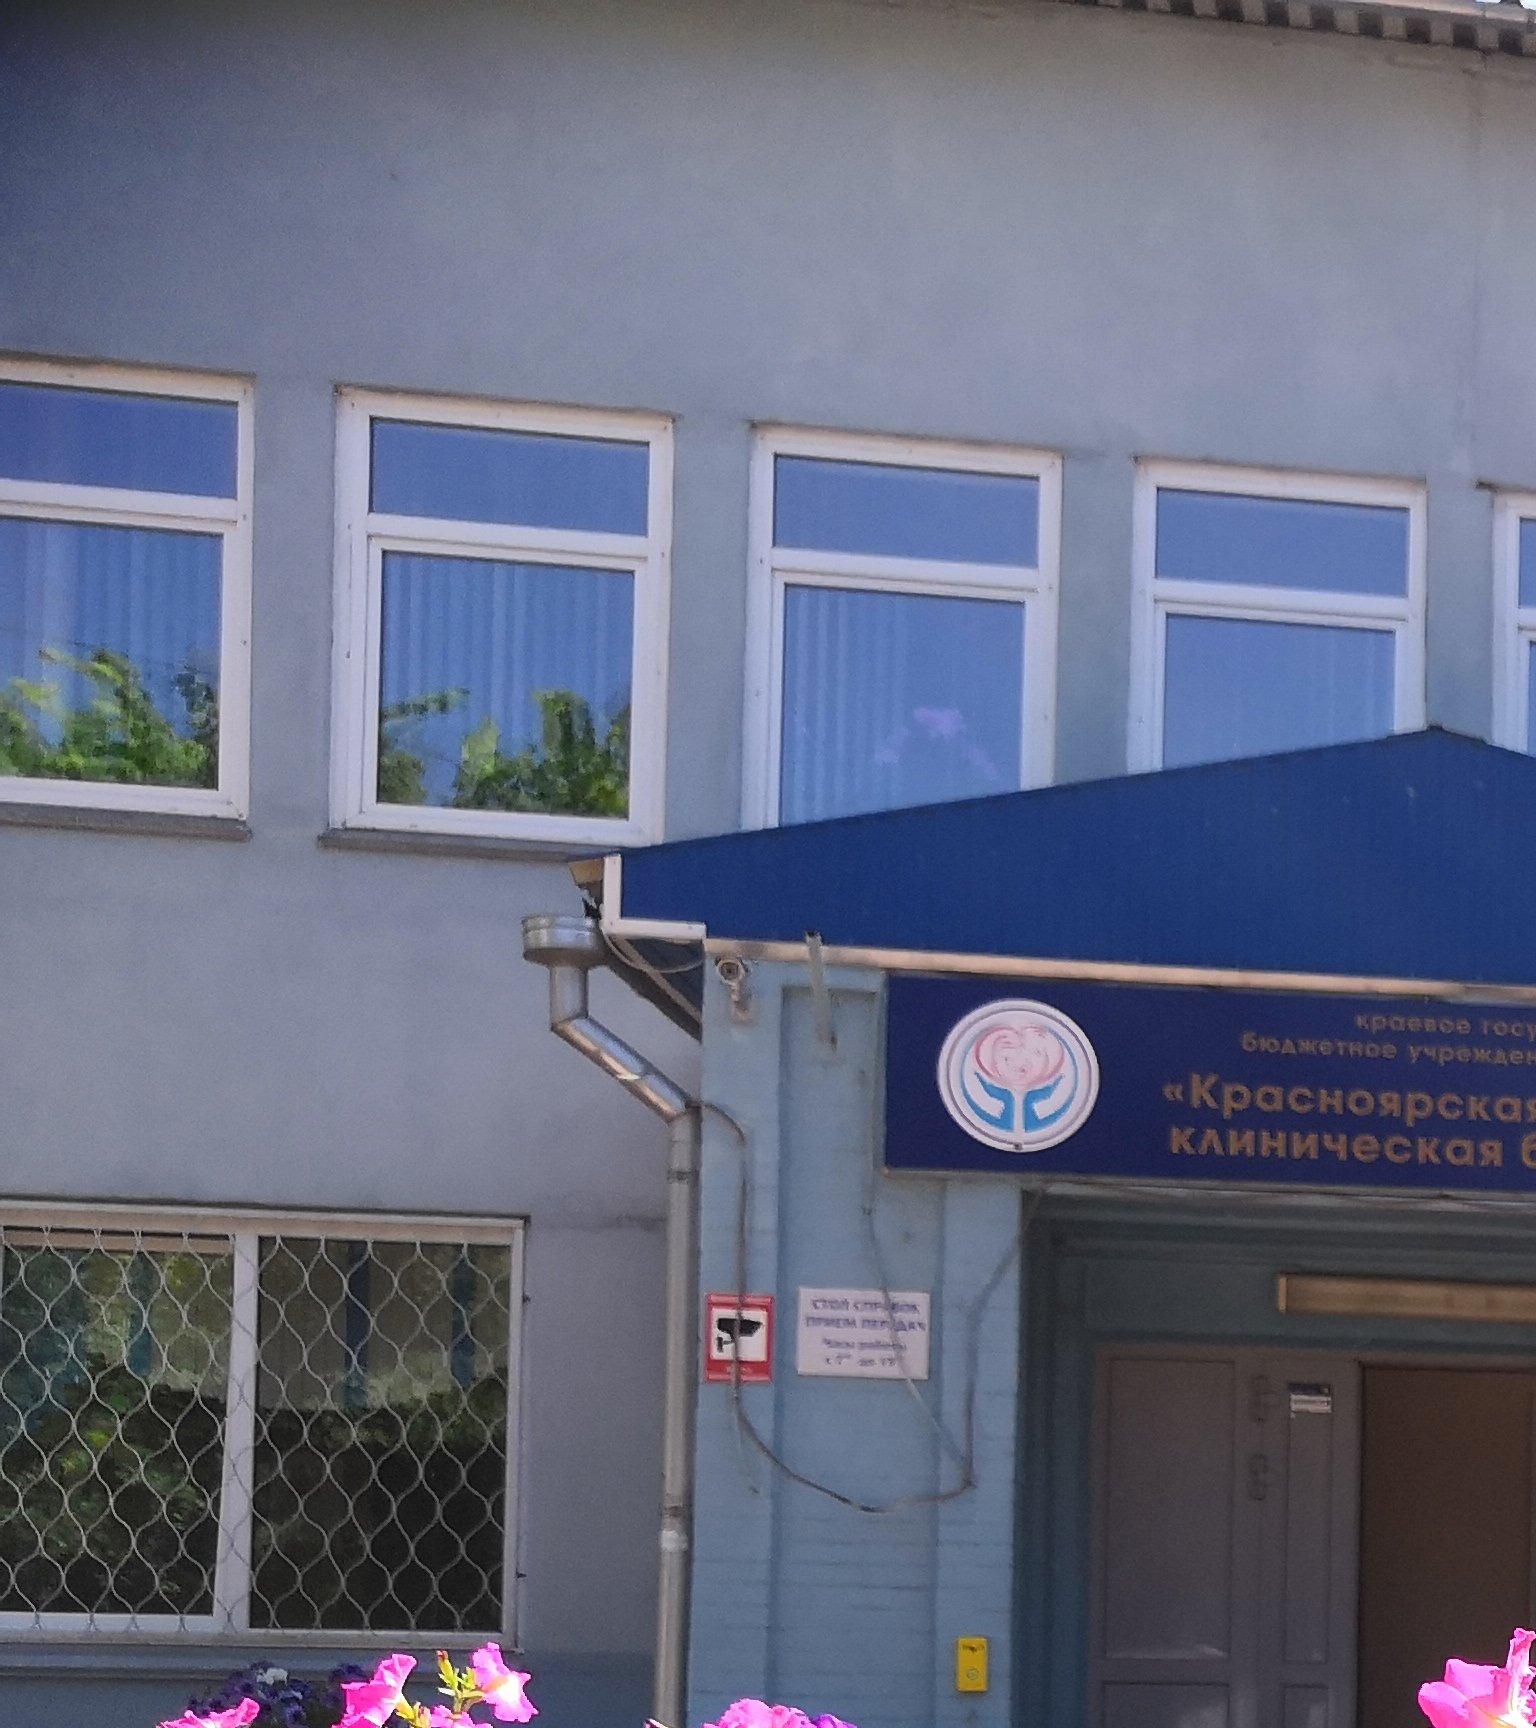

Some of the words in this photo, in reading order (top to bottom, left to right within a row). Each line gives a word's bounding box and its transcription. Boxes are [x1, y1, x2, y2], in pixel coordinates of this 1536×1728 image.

[1356, 1014, 1471, 1035] краевое
[1241, 1030, 1397, 1060] бюджетное
[1169, 1126, 1503, 1168] клиническая
